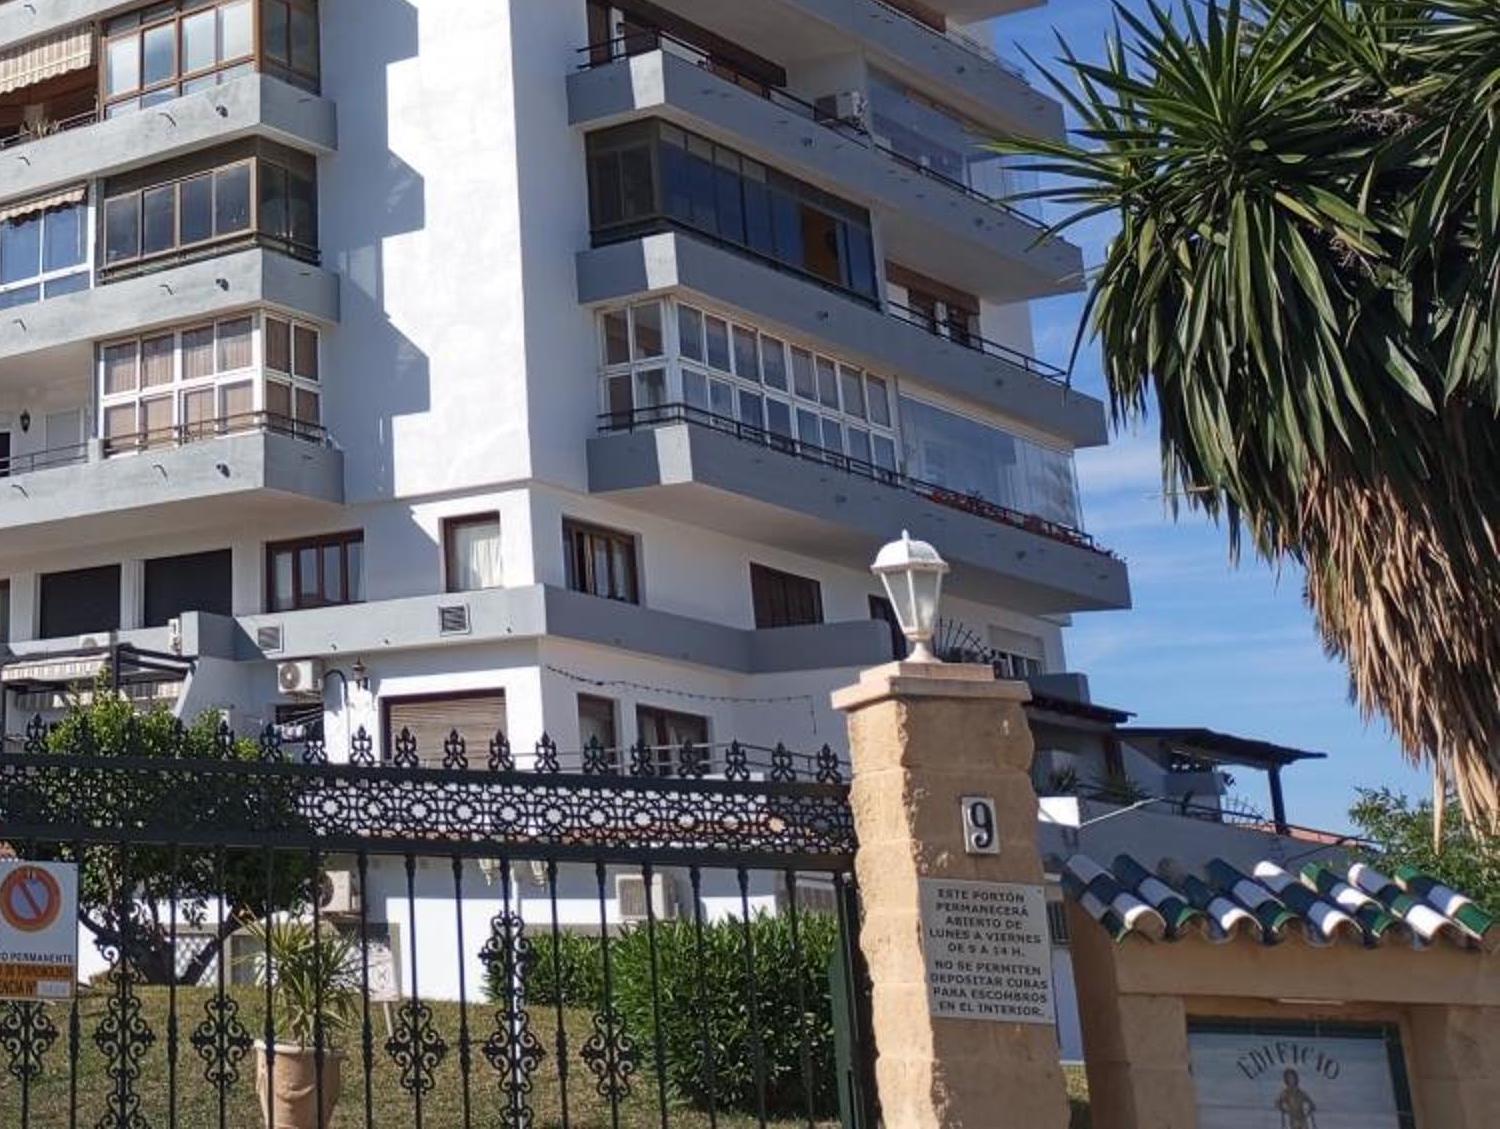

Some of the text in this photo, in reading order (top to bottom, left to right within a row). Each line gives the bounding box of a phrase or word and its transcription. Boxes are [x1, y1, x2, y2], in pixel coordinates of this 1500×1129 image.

[970, 801, 994, 849] 9
[938, 888, 1025, 903] ESTE PORTÓN
[936, 902, 1029, 917] PERMANECERÁ
[946, 916, 1023, 930] ABIERTO DE
[929, 928, 1041, 944] LUNES A VIERNES
[948, 942, 964, 953] DE
[980, 945, 989, 954] A
[10, 952, 73, 964] PERMANENTE
[934, 960, 1041, 975] NO SE PERMITEN
[930, 972, 1048, 989] DEPOSITAR CUBAS
[933, 987, 1047, 1003] PARA ESCOMBROS
[940, 1001, 955, 1011] EN
[960, 1002, 974, 1012] EL
[1236, 1042, 1342, 1080] EDIFICIO
